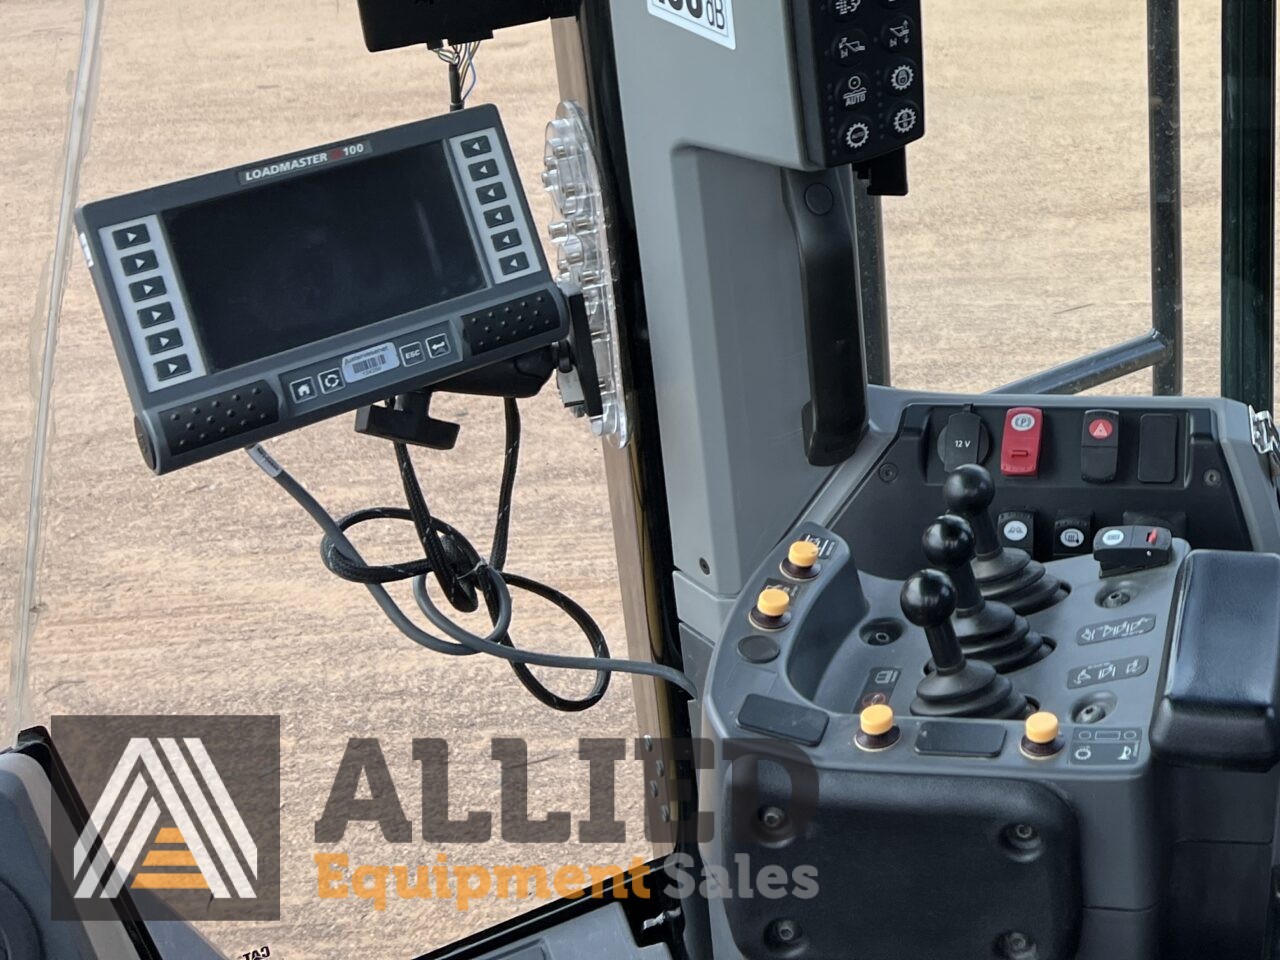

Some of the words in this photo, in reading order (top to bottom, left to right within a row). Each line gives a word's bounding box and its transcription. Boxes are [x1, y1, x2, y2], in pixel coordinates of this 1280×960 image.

[845, 93, 866, 107] AUTO
[245, 152, 328, 181] LOADMASTER
[405, 349, 420, 359] ESC
[955, 440, 964, 448] 12
